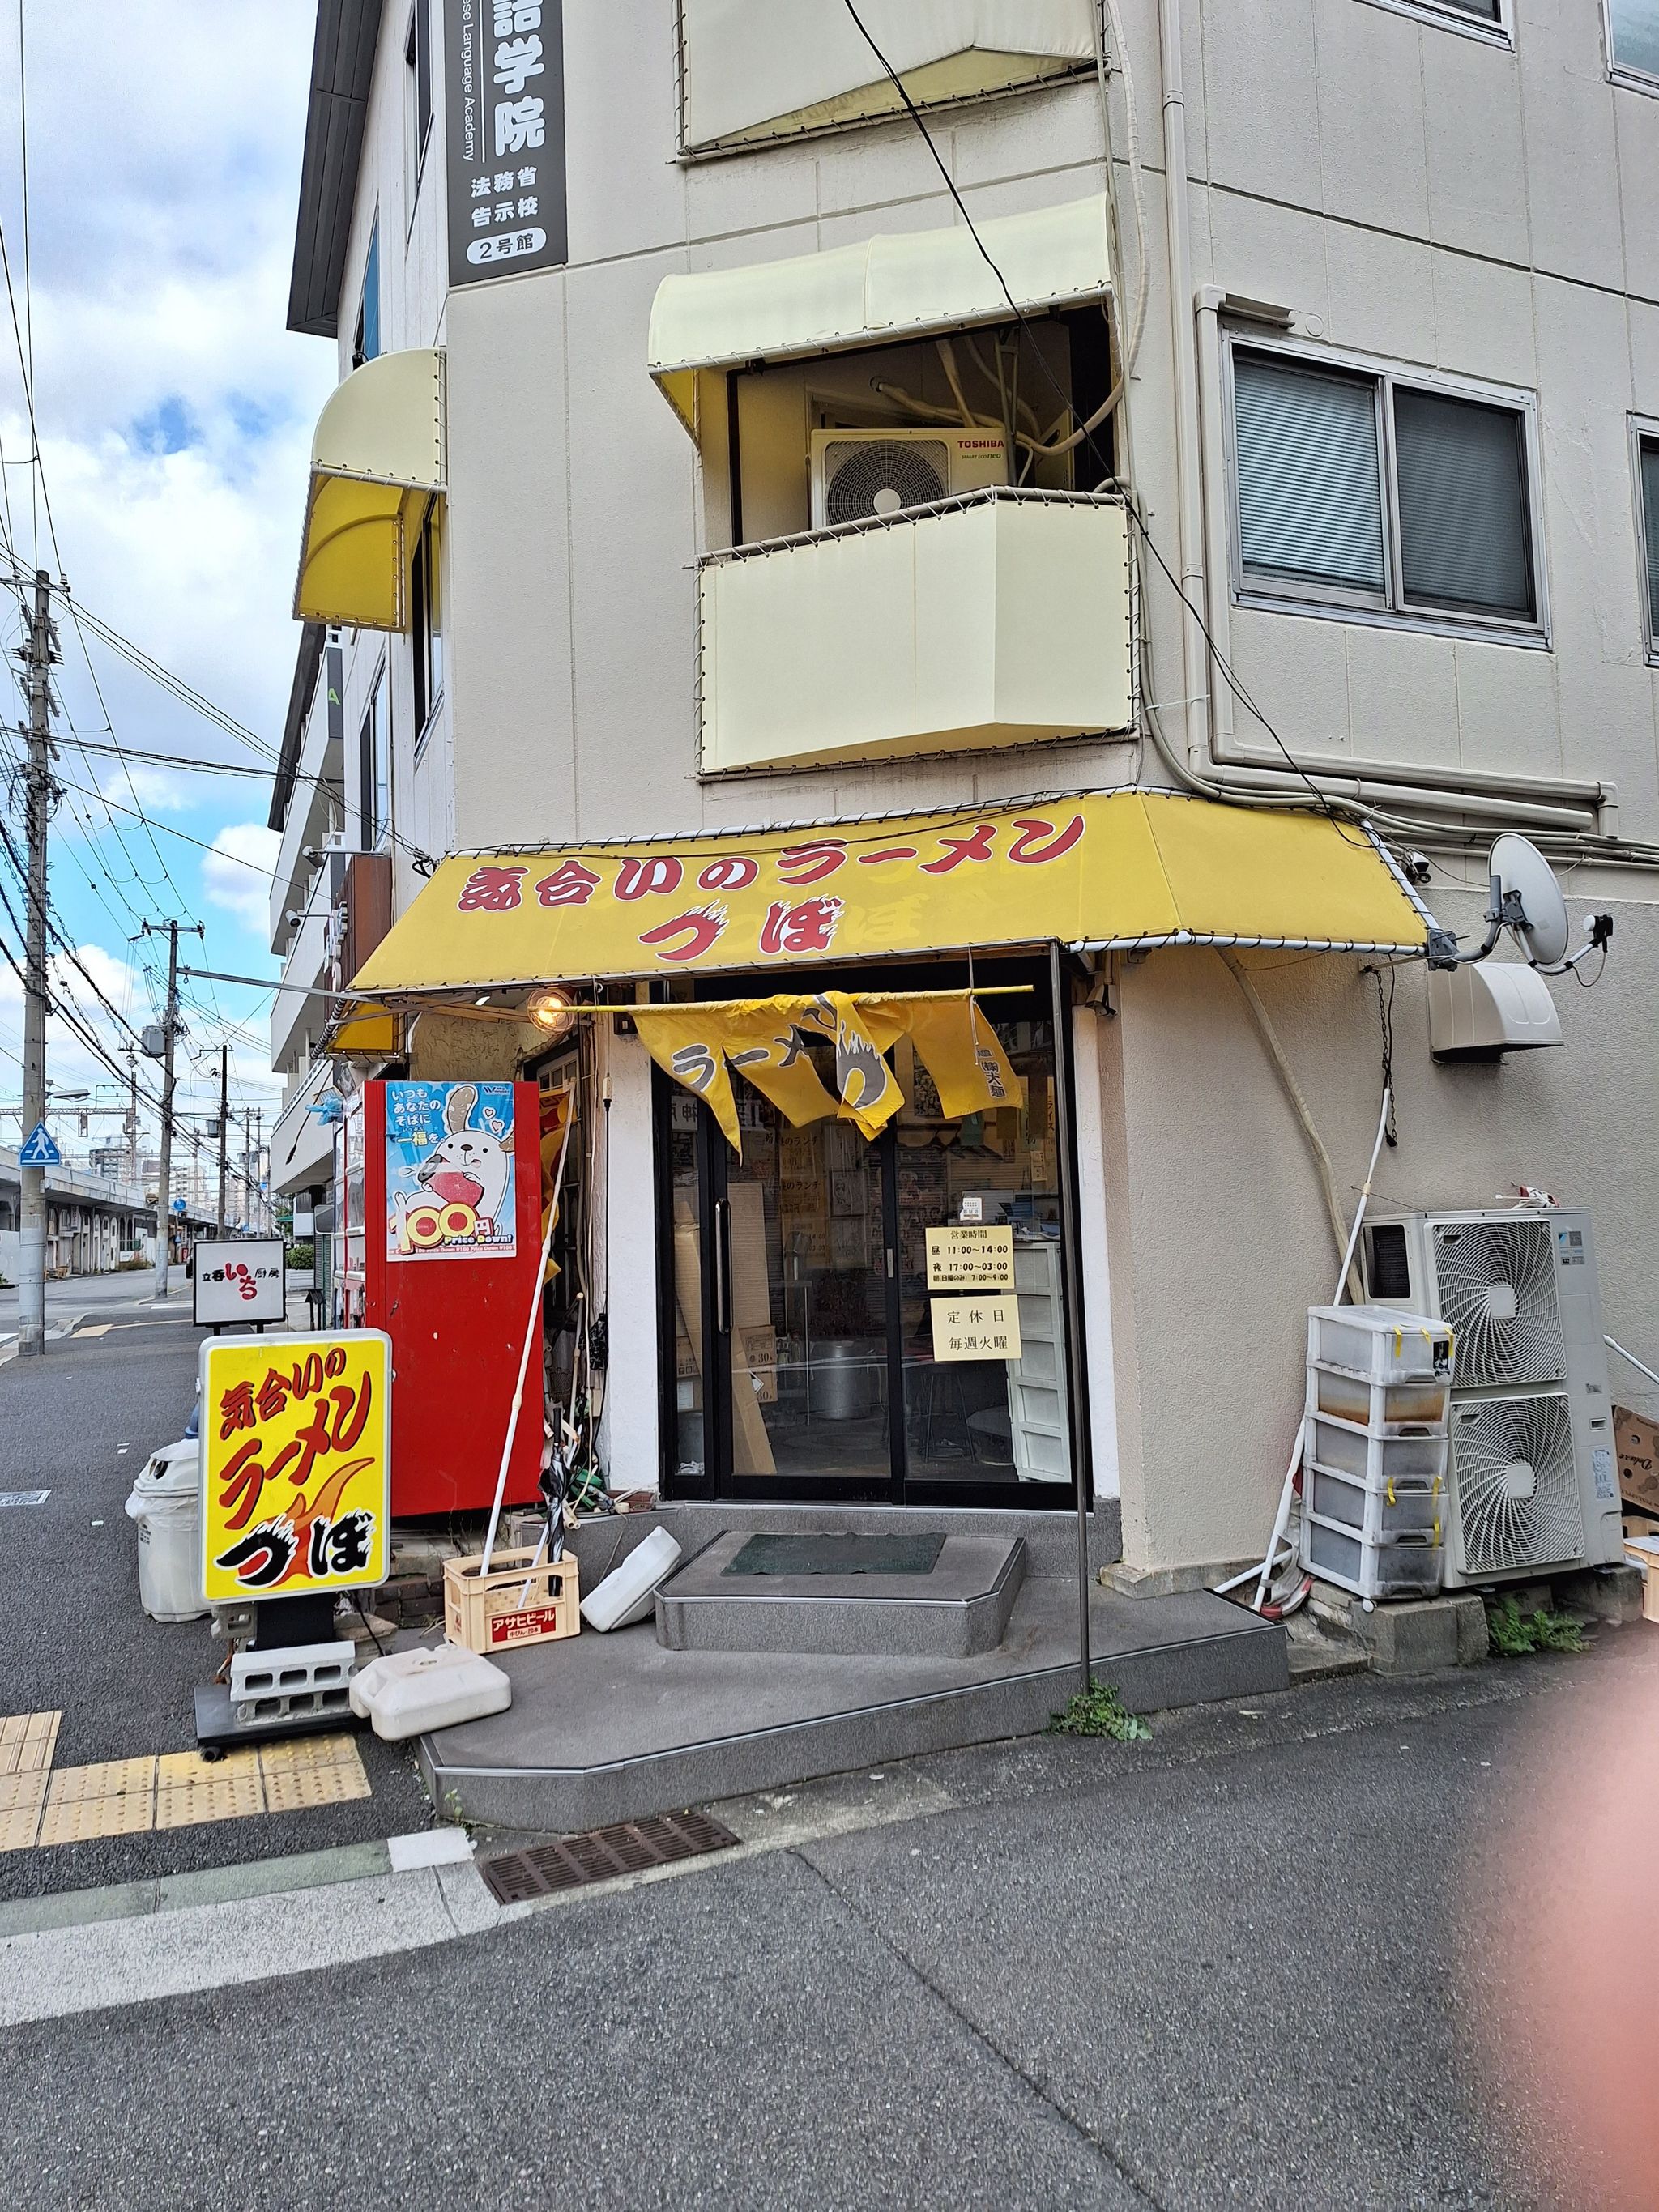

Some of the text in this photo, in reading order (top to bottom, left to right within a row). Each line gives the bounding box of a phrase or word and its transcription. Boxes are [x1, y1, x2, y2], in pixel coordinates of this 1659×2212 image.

[460, 23, 475, 93] Language
[493, 0, 545, 156] 語学院
[463, 96, 476, 161] Academy
[471, 166, 538, 198] 法務省
[471, 196, 539, 228] 告示校
[479, 232, 535, 259] 2号館
[957, 440, 1004, 449] TOSHIBA
[458, 814, 1085, 912] 気合いのラーメン
[638, 896, 846, 963] つぼ
[392, 1088, 428, 1101] いつも
[394, 1099, 441, 1114] あなたの
[395, 1114, 431, 1127] そばに
[397, 1131, 446, 1147] 一福を。
[389, 1202, 493, 1255] 100円
[444, 1234, 514, 1246] Price Down!
[950, 1230, 987, 1240] 営業時間
[931, 1246, 940, 1255] 昼
[932, 1263, 942, 1272] 夜
[225, 1262, 258, 1301] いち
[254, 1267, 280, 1279] 厨房
[947, 1309, 1005, 1324] 定休日
[949, 1336, 1008, 1351] 毎週火曜
[219, 1347, 347, 1442] 気合いの
[219, 1371, 371, 1530] ラーメン
[1618, 1453, 1653, 1471] Deluxe
[213, 1507, 377, 1588] つぼ
[493, 1609, 556, 1631] アサヒビール
